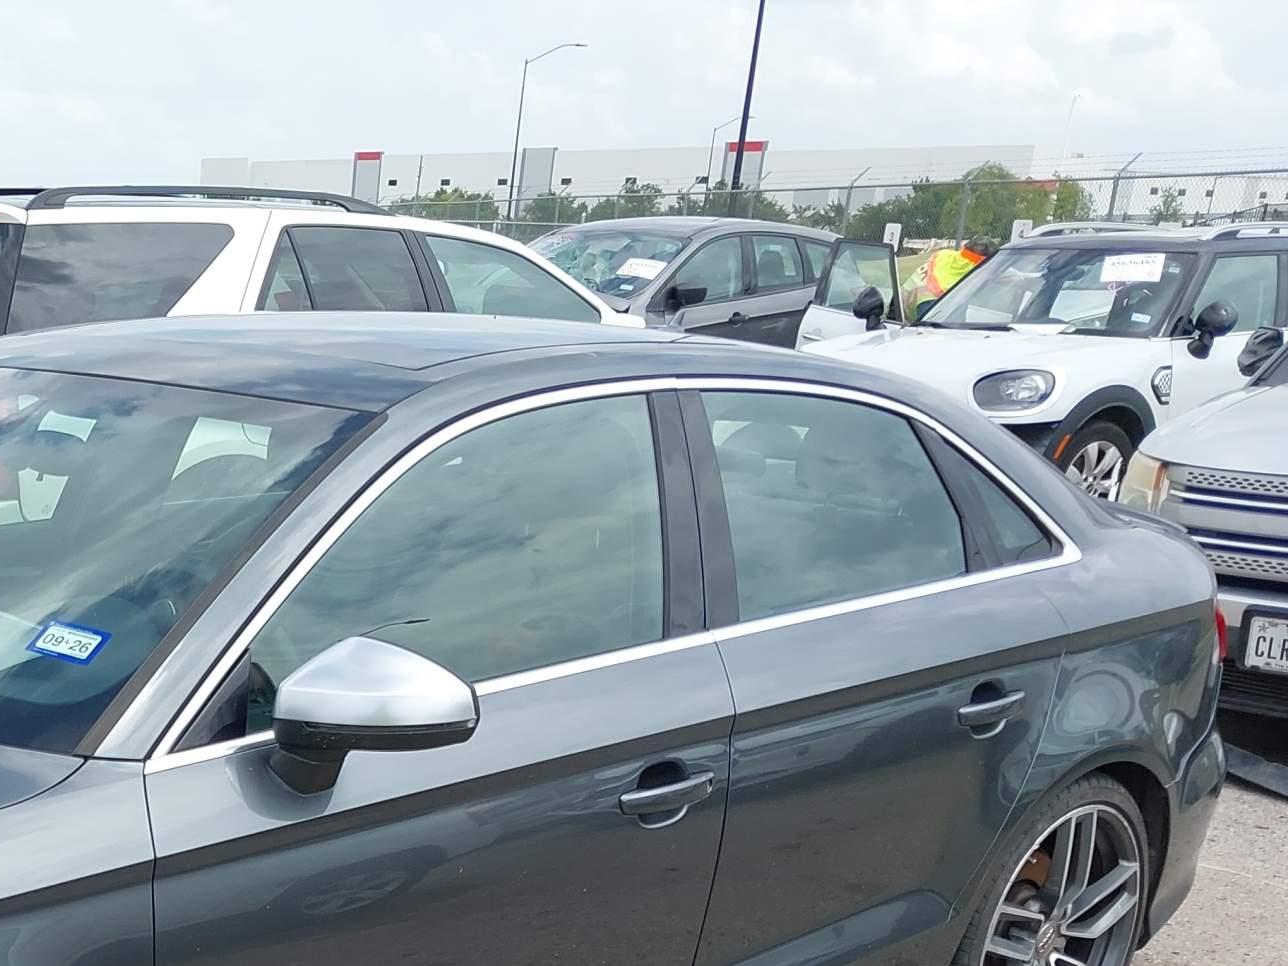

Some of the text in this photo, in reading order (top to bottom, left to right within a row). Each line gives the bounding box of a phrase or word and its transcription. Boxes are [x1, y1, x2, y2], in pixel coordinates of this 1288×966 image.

[42, 633, 65, 647] 09
[68, 639, 92, 654] 26
[1255, 635, 1288, 661] CLR
